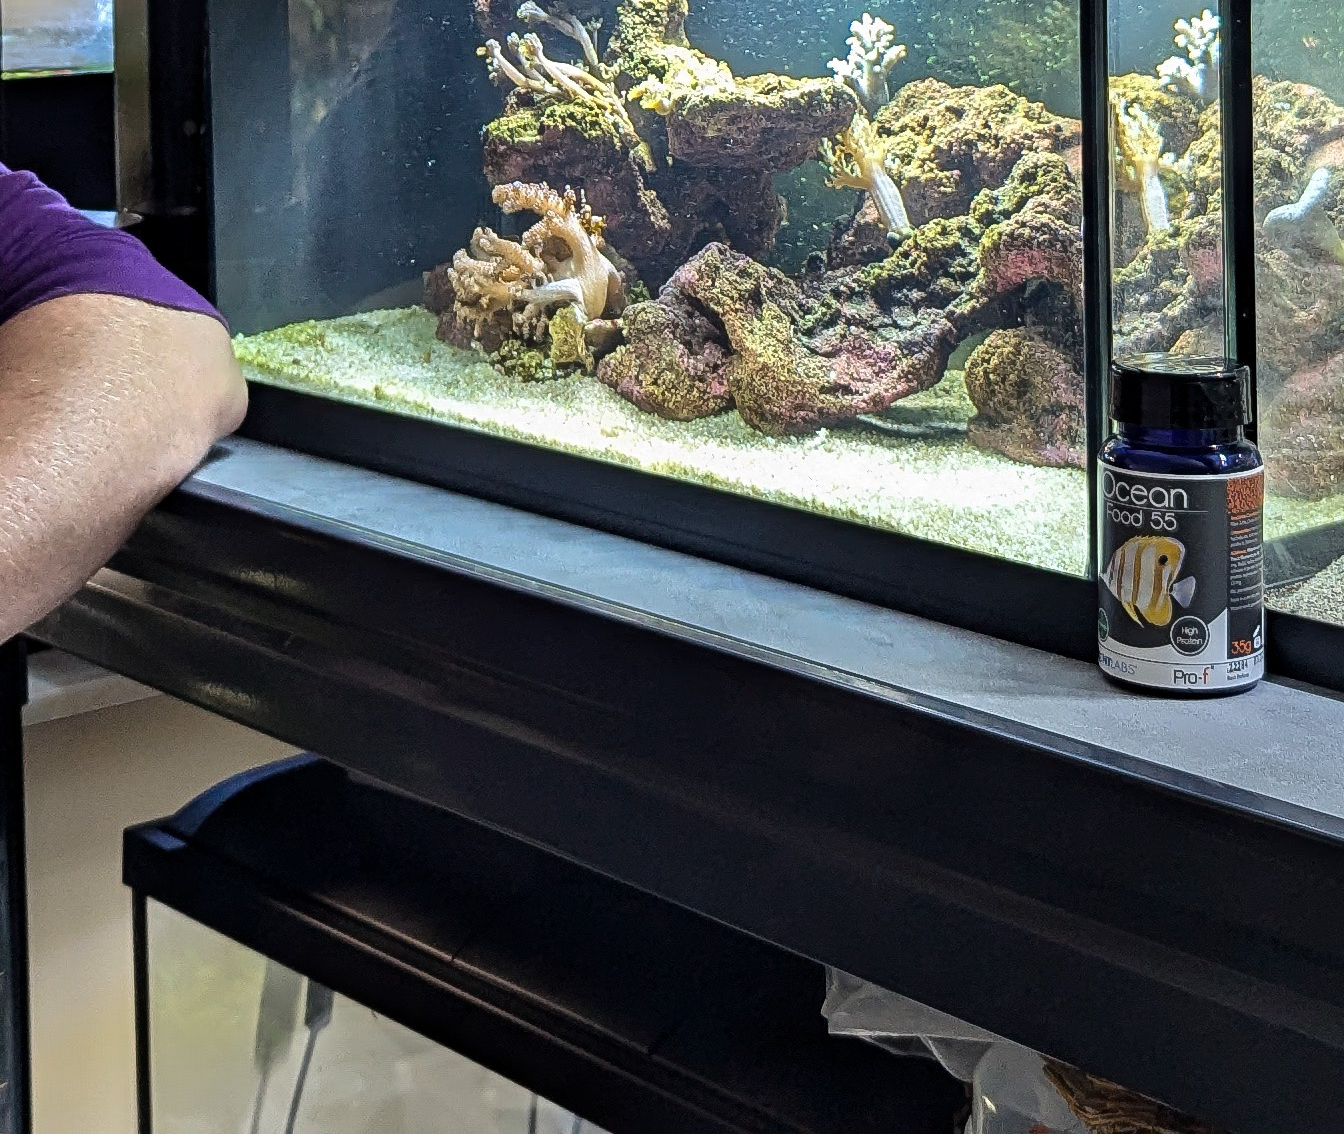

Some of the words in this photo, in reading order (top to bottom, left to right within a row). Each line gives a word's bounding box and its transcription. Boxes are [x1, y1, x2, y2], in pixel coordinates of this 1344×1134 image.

[1102, 471, 1188, 508] Ocean
[1106, 502, 1143, 527] Food
[1150, 511, 1177, 531] 55
[1181, 626, 1199, 636] High
[1176, 636, 1203, 645] Protein
[1230, 640, 1252, 654] 35g
[1173, 666, 1209, 685] Pro-f
